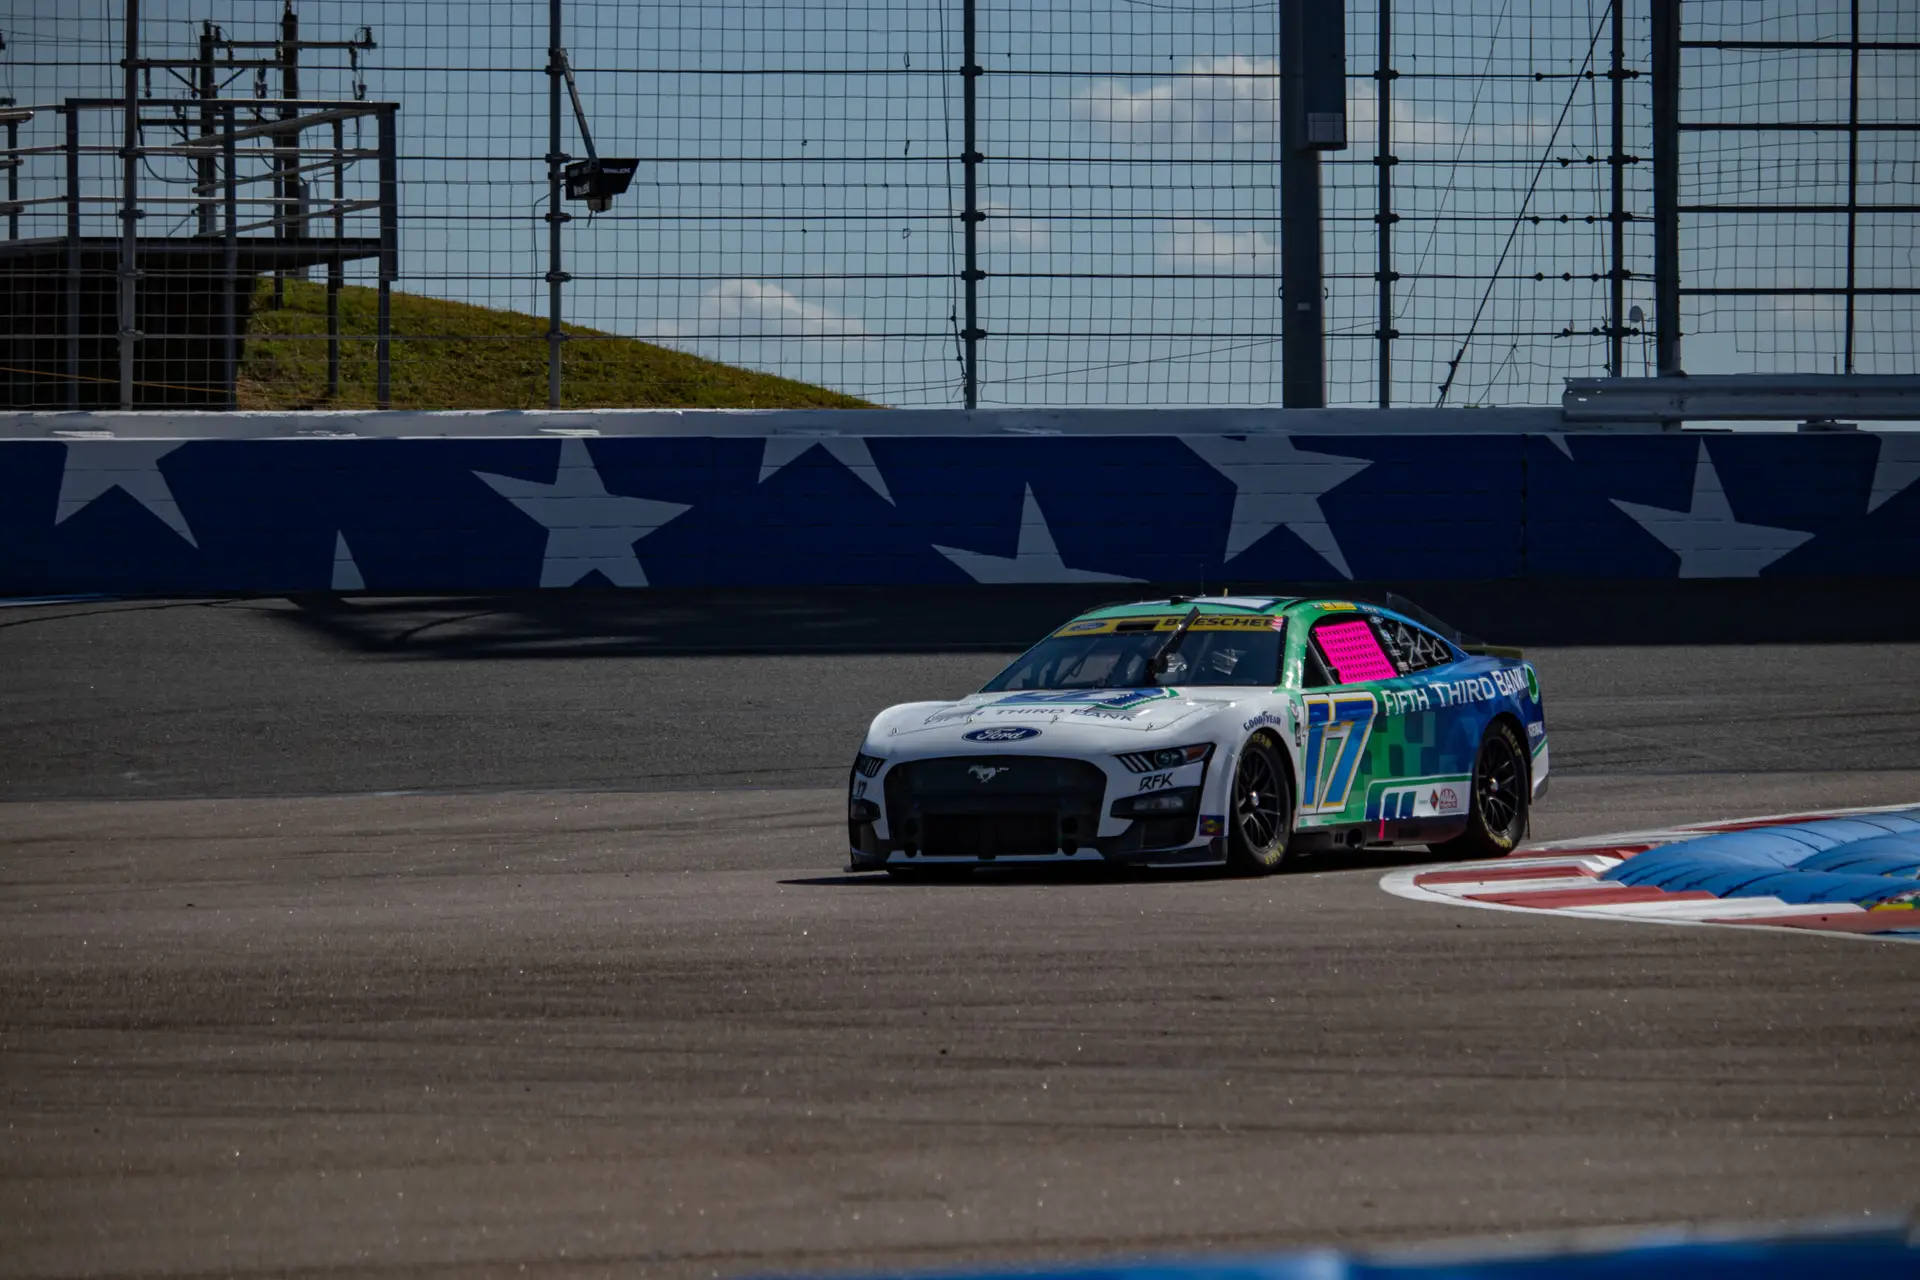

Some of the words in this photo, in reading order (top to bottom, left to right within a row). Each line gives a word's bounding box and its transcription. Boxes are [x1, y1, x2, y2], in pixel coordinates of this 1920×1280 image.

[1380, 688, 1430, 716] FIFTH
[1428, 677, 1496, 707] THIRD
[1491, 666, 1527, 696] BANK
[1243, 711, 1282, 731] GOODYEAR
[1300, 692, 1377, 814] 17
[1138, 772, 1174, 791] RFK
